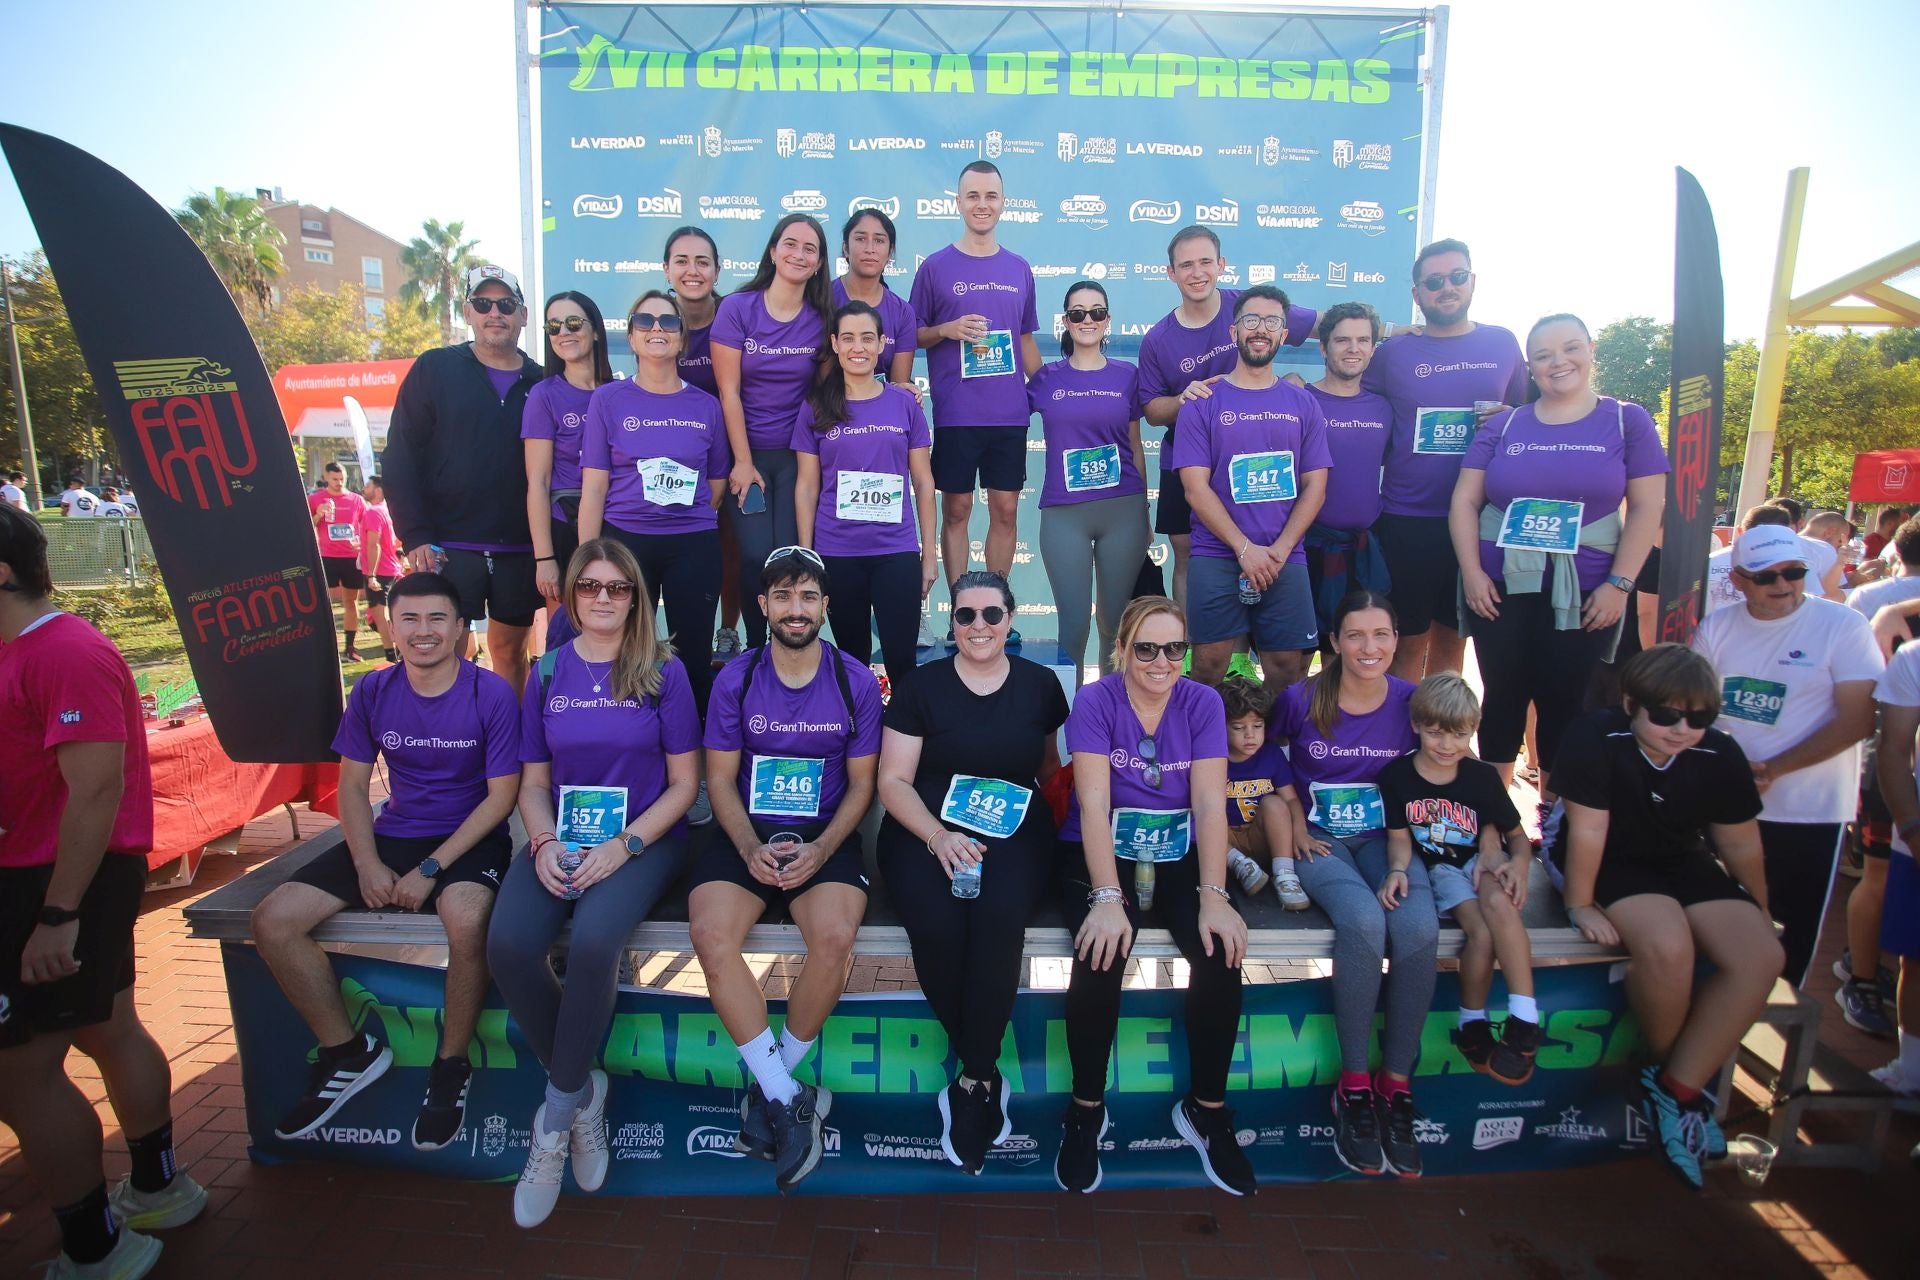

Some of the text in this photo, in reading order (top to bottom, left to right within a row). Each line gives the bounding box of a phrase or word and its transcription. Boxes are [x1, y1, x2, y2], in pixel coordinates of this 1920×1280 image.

[695, 44, 976, 94] CARRERA
[985, 49, 1060, 97] DE
[1068, 50, 1391, 105] EMPRESAS
[571, 136, 646, 149] LA VERDAD
[848, 137, 926, 151] LA VERDAD
[1126, 142, 1204, 157] LA VERDAD
[580, 200, 616, 212] VIDAL
[638, 196, 682, 214] DSM
[731, 195, 760, 206] GLOBAL
[1009, 198, 1038, 209] GLOBAL
[1137, 205, 1175, 218] VIDAL
[1195, 204, 1239, 222] DSM
[1289, 205, 1318, 215] GLOBAL
[574, 258, 610, 273] itres
[1030, 264, 1077, 276] talayas
[1353, 271, 1386, 284] Hero
[602, 318, 628, 331] ERD
[284, 370, 397, 392] Ayuntamiento de Murcia
[138, 383, 226, 398] 1925 2025
[1433, 423, 1468, 438] 539
[1080, 459, 1108, 475] 538
[1246, 469, 1279, 486] 547
[850, 490, 892, 505] 2108
[1521, 513, 1562, 533] 552
[223, 571, 282, 594] ATLETISMO
[191, 575, 319, 643] FAMU
[1017, 602, 1058, 613] atalaya
[1733, 688, 1781, 711] 1230
[772, 775, 813, 794] 546
[968, 789, 1008, 816] 542
[571, 806, 606, 826] 557
[1328, 803, 1366, 821] 543
[1133, 827, 1171, 844] 541
[688, 1104, 741, 1114] PATROCINAN
[618, 1126, 664, 1138] murcia
[624, 1122, 664, 1132] región de
[1481, 1120, 1519, 1130] AQUA
[1533, 1123, 1607, 1138] ESTRELLA
[320, 1127, 402, 1145] VERDAD
[697, 1134, 735, 1149] VIDA
[883, 1135, 943, 1147] AMC GLOBA
[1479, 1129, 1517, 1139] DEUS
[508, 1139, 518, 1148] de
[611, 1137, 665, 1148] ATLETISMO
[1001, 1140, 1035, 1149] OZO
[1128, 1136, 1193, 1150] atalaya
[616, 1148, 663, 1160] Corriendo
